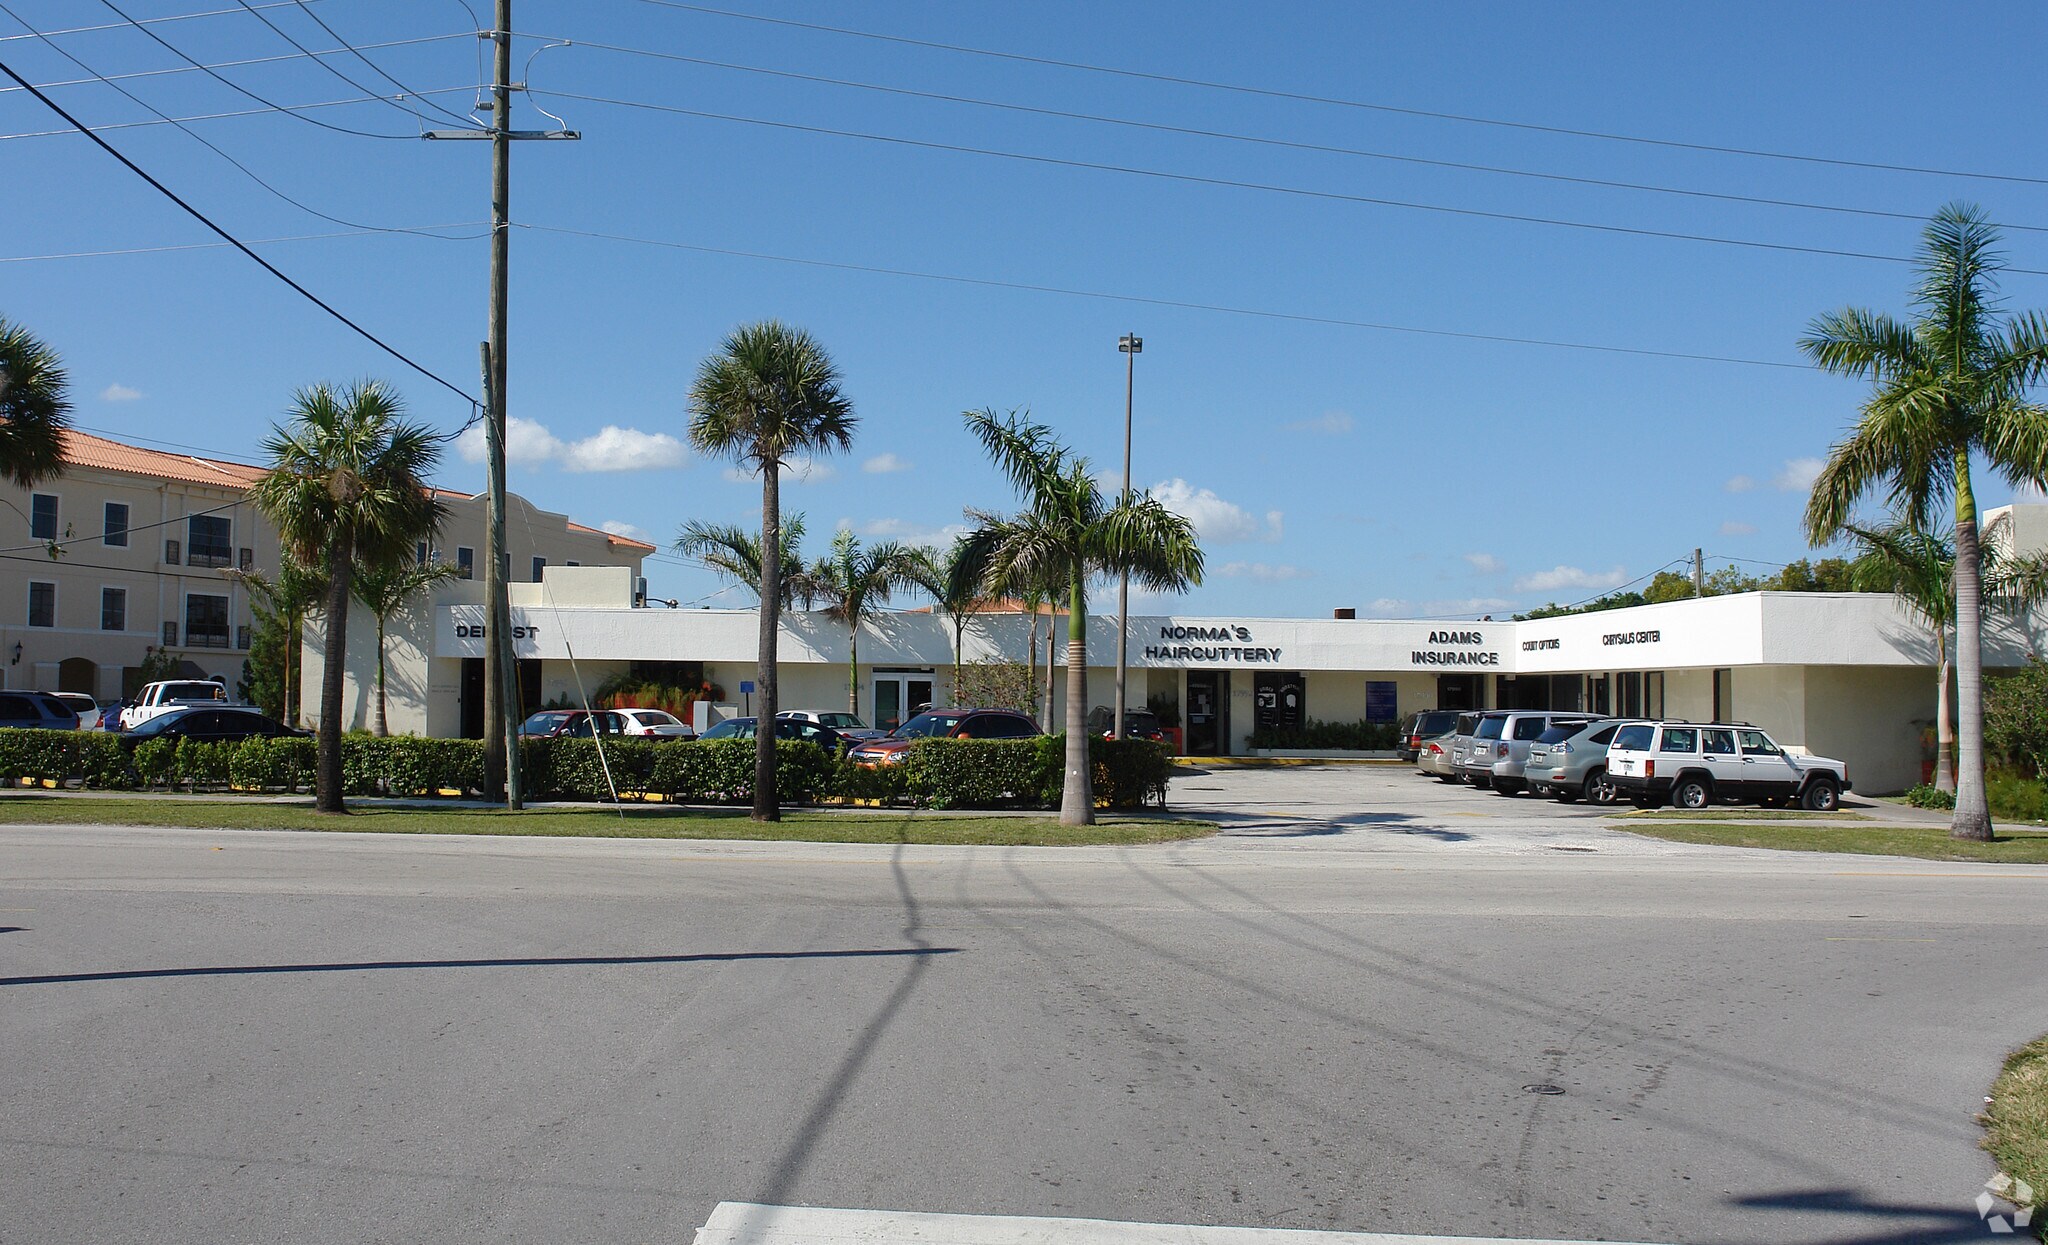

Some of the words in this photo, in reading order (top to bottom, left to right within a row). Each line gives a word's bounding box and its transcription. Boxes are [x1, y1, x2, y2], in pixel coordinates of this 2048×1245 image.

[456, 625, 538, 639] DEST
[1160, 624, 1251, 642] NORMA'S
[1428, 631, 1482, 645] ADAMS
[1602, 632, 1635, 646] CHRYSALIS
[1635, 630, 1661, 643] CENTER
[1145, 646, 1281, 662] HAIRCUTTERY
[1411, 651, 1499, 665] INSURANCE
